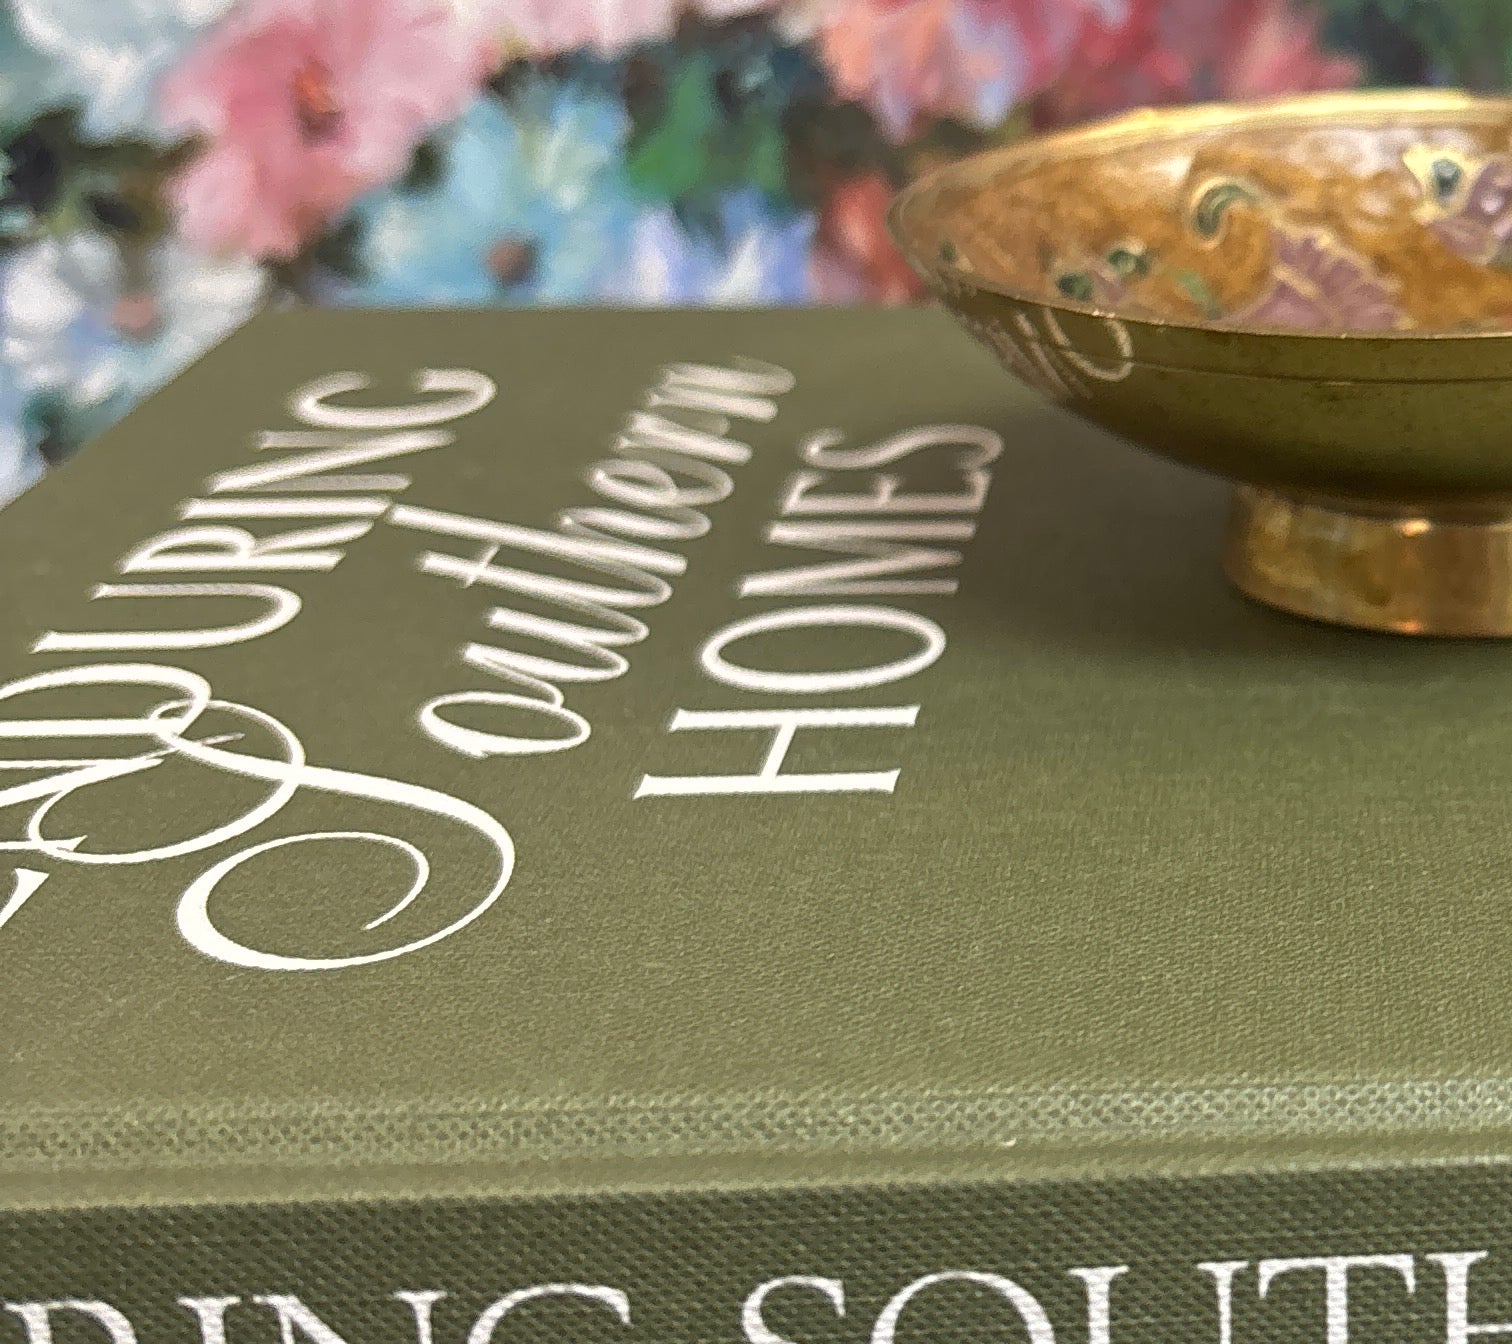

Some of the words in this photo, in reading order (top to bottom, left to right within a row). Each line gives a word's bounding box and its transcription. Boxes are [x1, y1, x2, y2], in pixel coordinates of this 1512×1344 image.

[0, 369, 496, 927] NDURING
[28, 355, 795, 972] Southern
[632, 423, 1003, 800] HOMES
